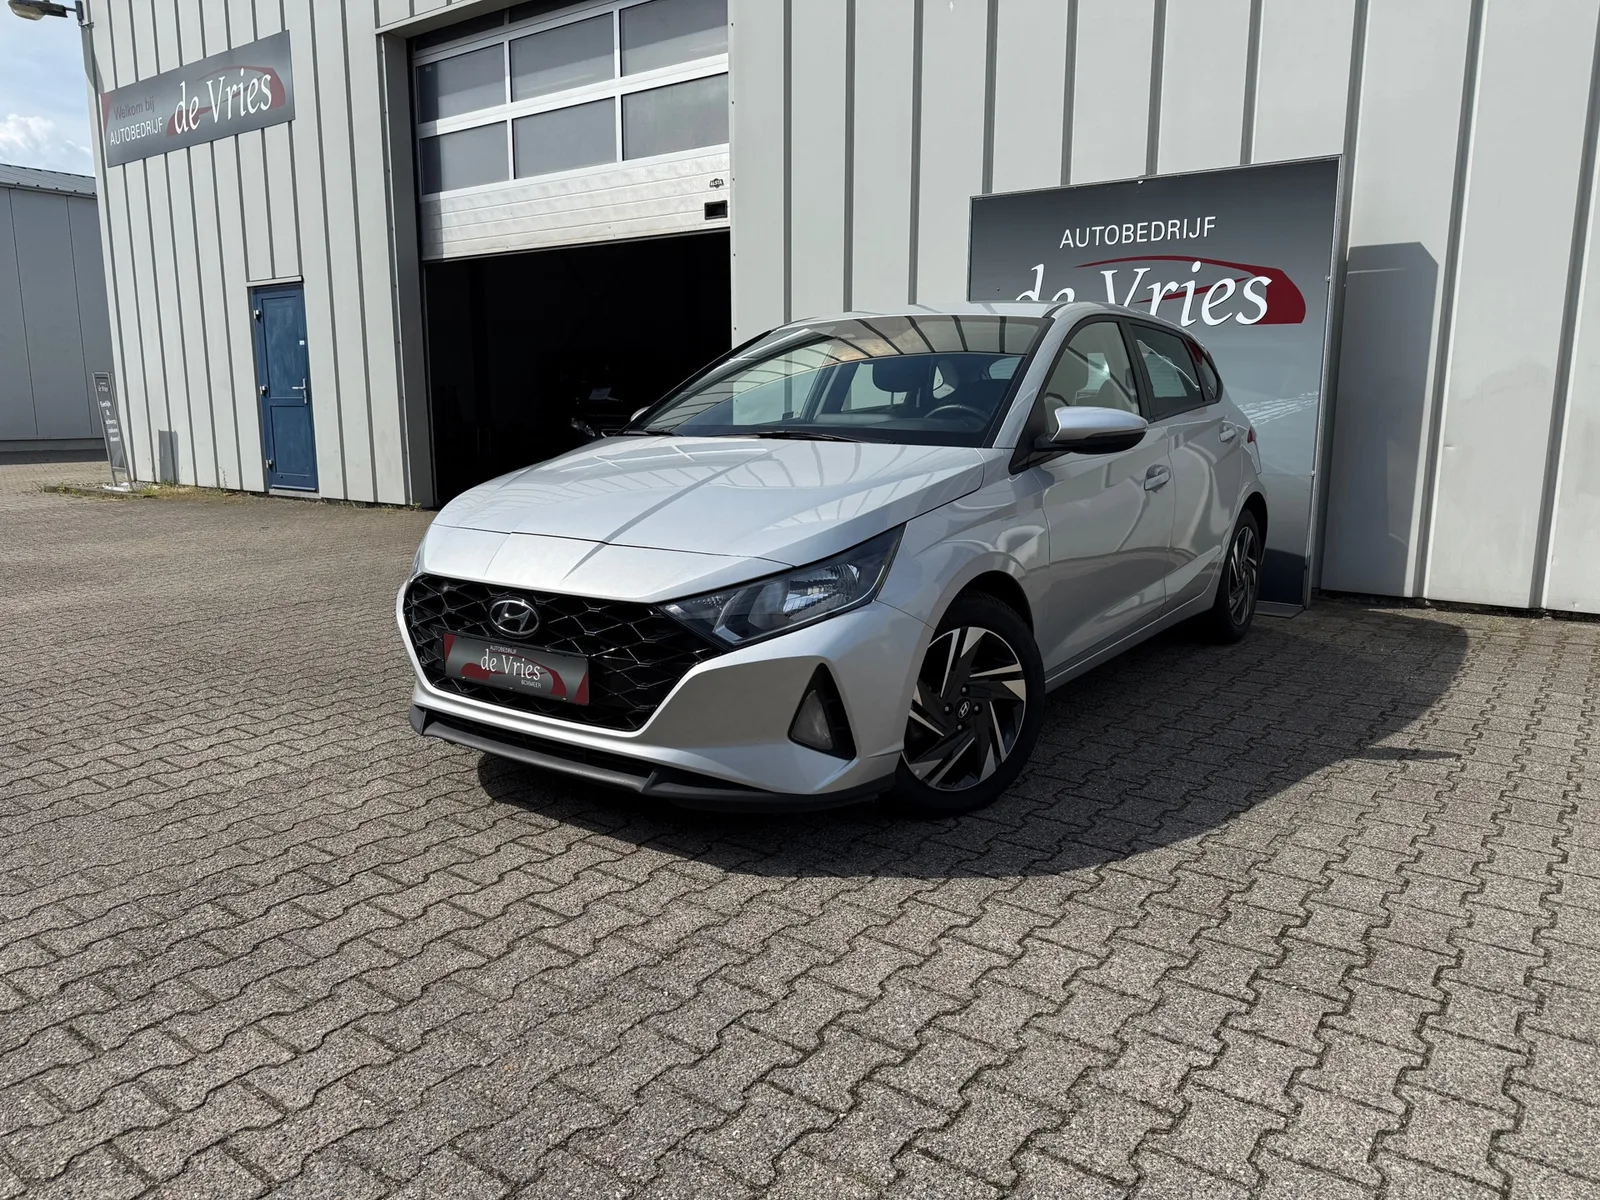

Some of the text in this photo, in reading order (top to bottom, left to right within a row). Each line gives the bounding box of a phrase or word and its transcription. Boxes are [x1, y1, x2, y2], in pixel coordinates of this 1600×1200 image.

[113, 96, 155, 121] Welkom bij
[174, 67, 272, 134] de Vries
[110, 116, 163, 146] AUTOBEDRIJF
[1059, 216, 1216, 249] AUTOBEDRIJF
[1100, 260, 1273, 327] Vries
[480, 649, 541, 681] de Vries
